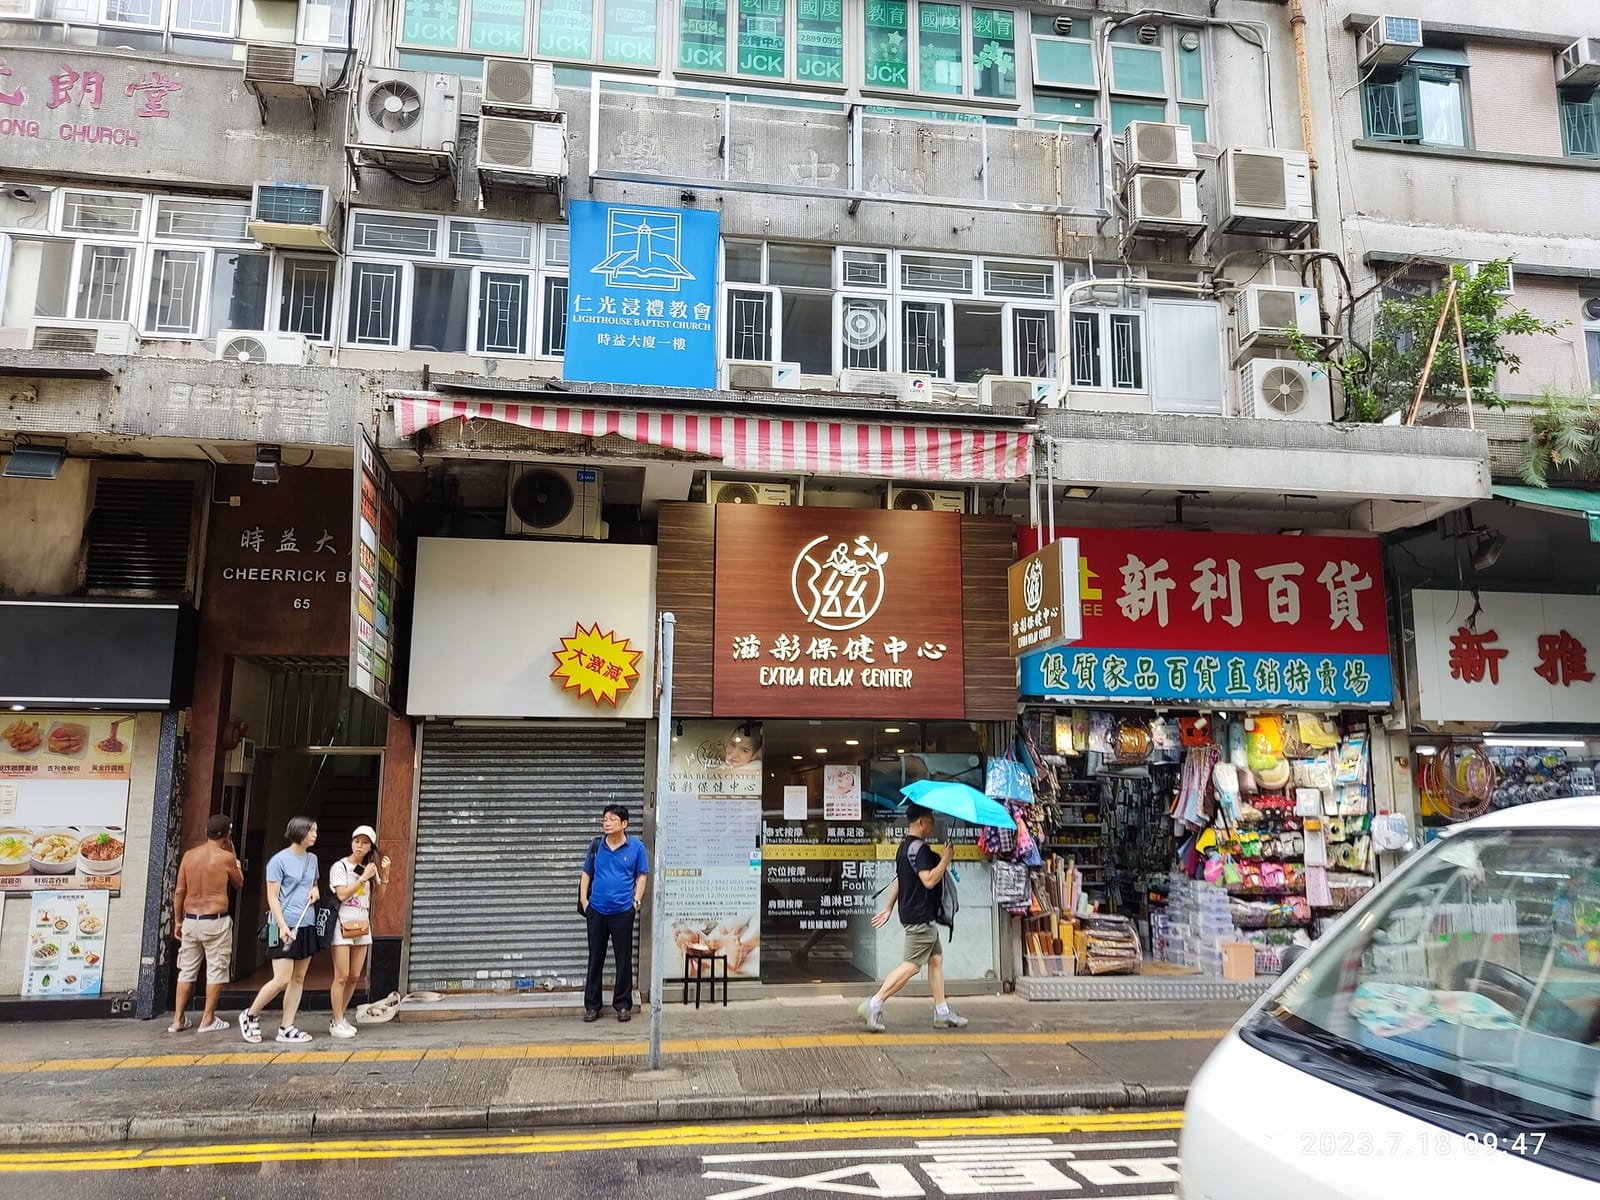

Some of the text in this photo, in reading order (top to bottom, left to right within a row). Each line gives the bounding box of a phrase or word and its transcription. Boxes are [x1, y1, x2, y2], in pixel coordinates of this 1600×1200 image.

[867, 5, 905, 24] 教育
[921, 10, 960, 30] 國度
[407, 22, 456, 41] JCK
[690, 21, 716, 32] JCK
[975, 15, 1011, 35] 教育
[473, 29, 520, 47] JCK
[542, 33, 589, 54] JCK
[607, 40, 652, 60] JCK
[681, 47, 723, 67] JCK
[740, 54, 782, 73] JCK
[799, 59, 841, 80] JCK
[867, 65, 906, 83] JCK
[59, 123, 139, 147] CHURCH
[573, 294, 711, 321] 仁光浸禮教會
[572, 315, 711, 331] LIGHTHOUSE BAPTIST CHURCH
[240, 526, 352, 555] 時益大
[223, 568, 327, 582] CHEERRICK
[1116, 553, 1373, 632] 新利百貨
[293, 598, 311, 609] 65
[733, 634, 947, 664] 滋彩保健中心
[1449, 626, 1596, 687] 新雅
[760, 667, 913, 688] EXTRA RELAX CENTER
[1040, 652, 1370, 697] 優質家品百貨直銷特賣場
[842, 881, 865, 890] Foot
